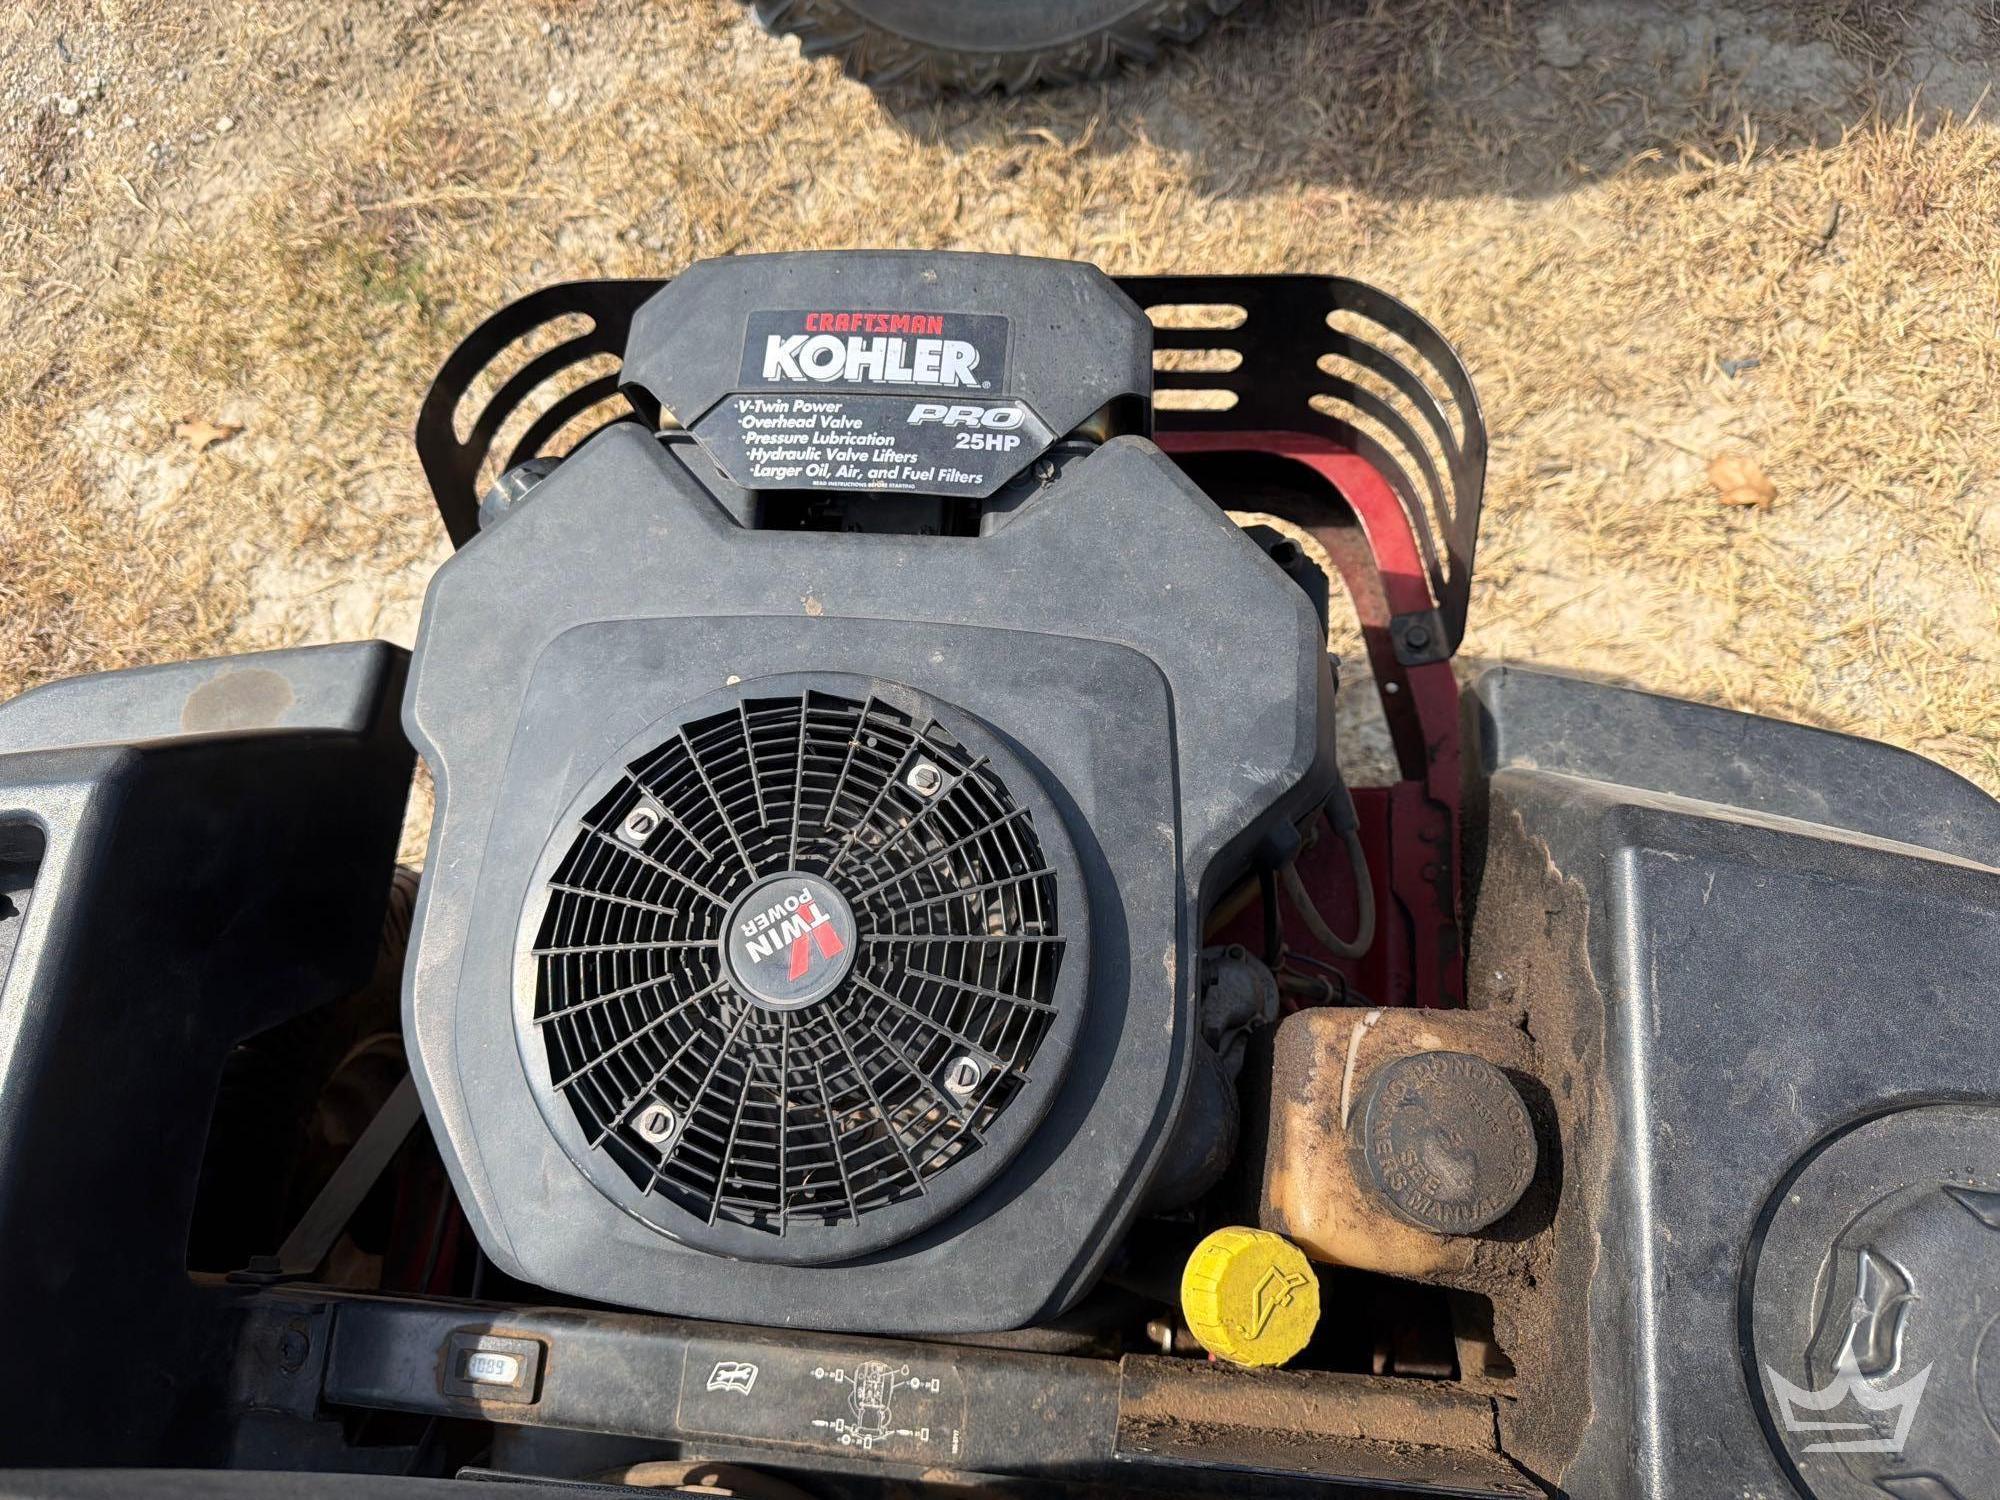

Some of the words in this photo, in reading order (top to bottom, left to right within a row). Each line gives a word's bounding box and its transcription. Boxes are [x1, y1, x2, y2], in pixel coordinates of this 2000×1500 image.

[806, 313, 944, 335] CRAFTSMAN
[792, 400, 842, 415] Power
[906, 404, 1026, 430] PRO
[742, 415, 817, 429] Overhead
[819, 416, 863, 430] Valve
[745, 431, 811, 445] Pressure
[813, 432, 895, 447] Lubrication
[955, 432, 1021, 453] 25HP
[749, 447, 822, 463] Hydraulic
[826, 448, 870, 463] Valve
[872, 449, 918, 464] Lifters
[753, 463, 802, 481] Larger
[805, 463, 831, 480] Oil,
[836, 465, 863, 481] Air,
[868, 466, 897, 481] and
[902, 468, 934, 483] Fuel
[937, 469, 984, 485] Filters
[740, 887, 813, 938] POWER
[745, 902, 831, 964] TWIN
